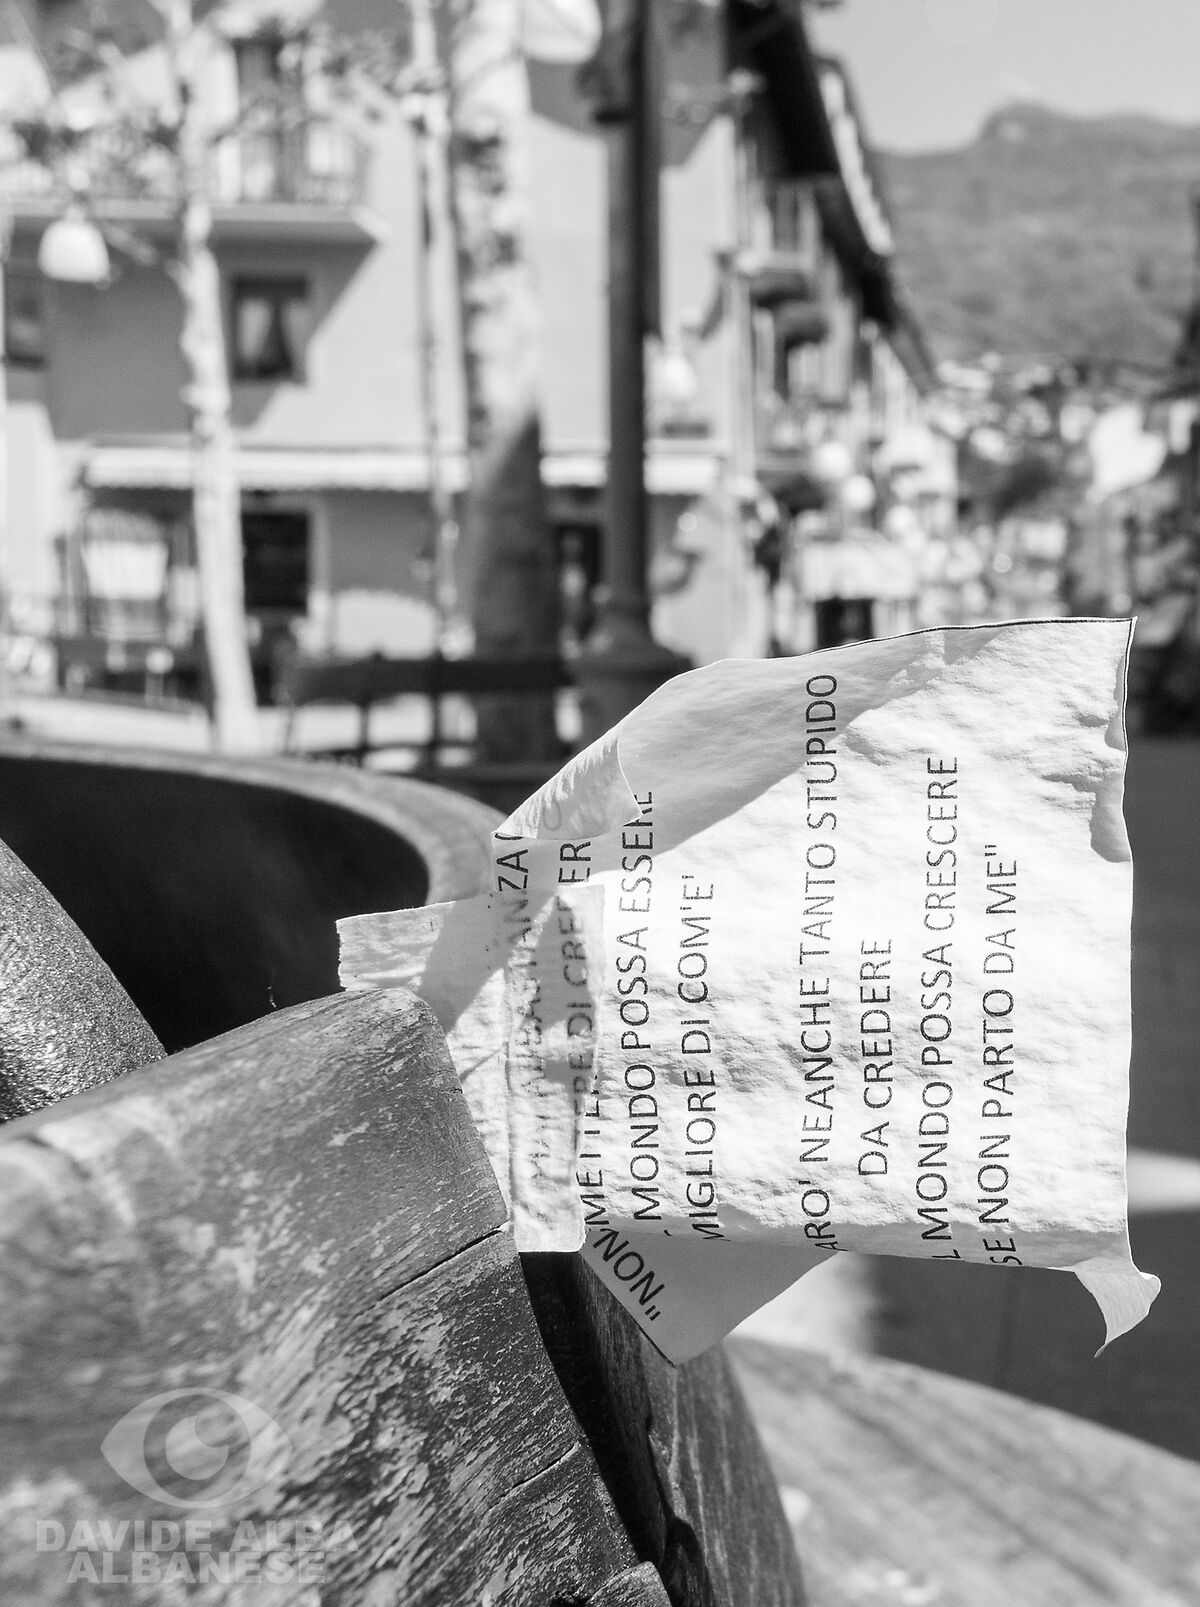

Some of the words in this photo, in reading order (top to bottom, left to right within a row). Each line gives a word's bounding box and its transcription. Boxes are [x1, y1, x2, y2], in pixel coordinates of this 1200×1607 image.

[805, 674, 838, 830] STUPIDO
[799, 843, 836, 965] TANTO
[923, 757, 958, 931] CRESCERE
[984, 844, 1018, 914] ME"
[615, 927, 651, 1050] POSSA
[677, 874, 714, 1004] COM'E'
[983, 928, 1017, 974] DA
[567, 1002, 593, 1038] DI
[680, 1019, 711, 1054] DI
[859, 938, 893, 1109] CREDERE
[920, 943, 953, 1066] POSSA
[982, 989, 1014, 1118] PARTO
[799, 977, 835, 1162] NEANCHE
[624, 1064, 662, 1220] MONDO
[683, 1070, 731, 1241] MIGLIORE
[857, 1121, 890, 1176] DA
[915, 1082, 954, 1240] MONDO
[976, 1134, 1011, 1224] NON
[982, 1237, 1023, 1266] SE
